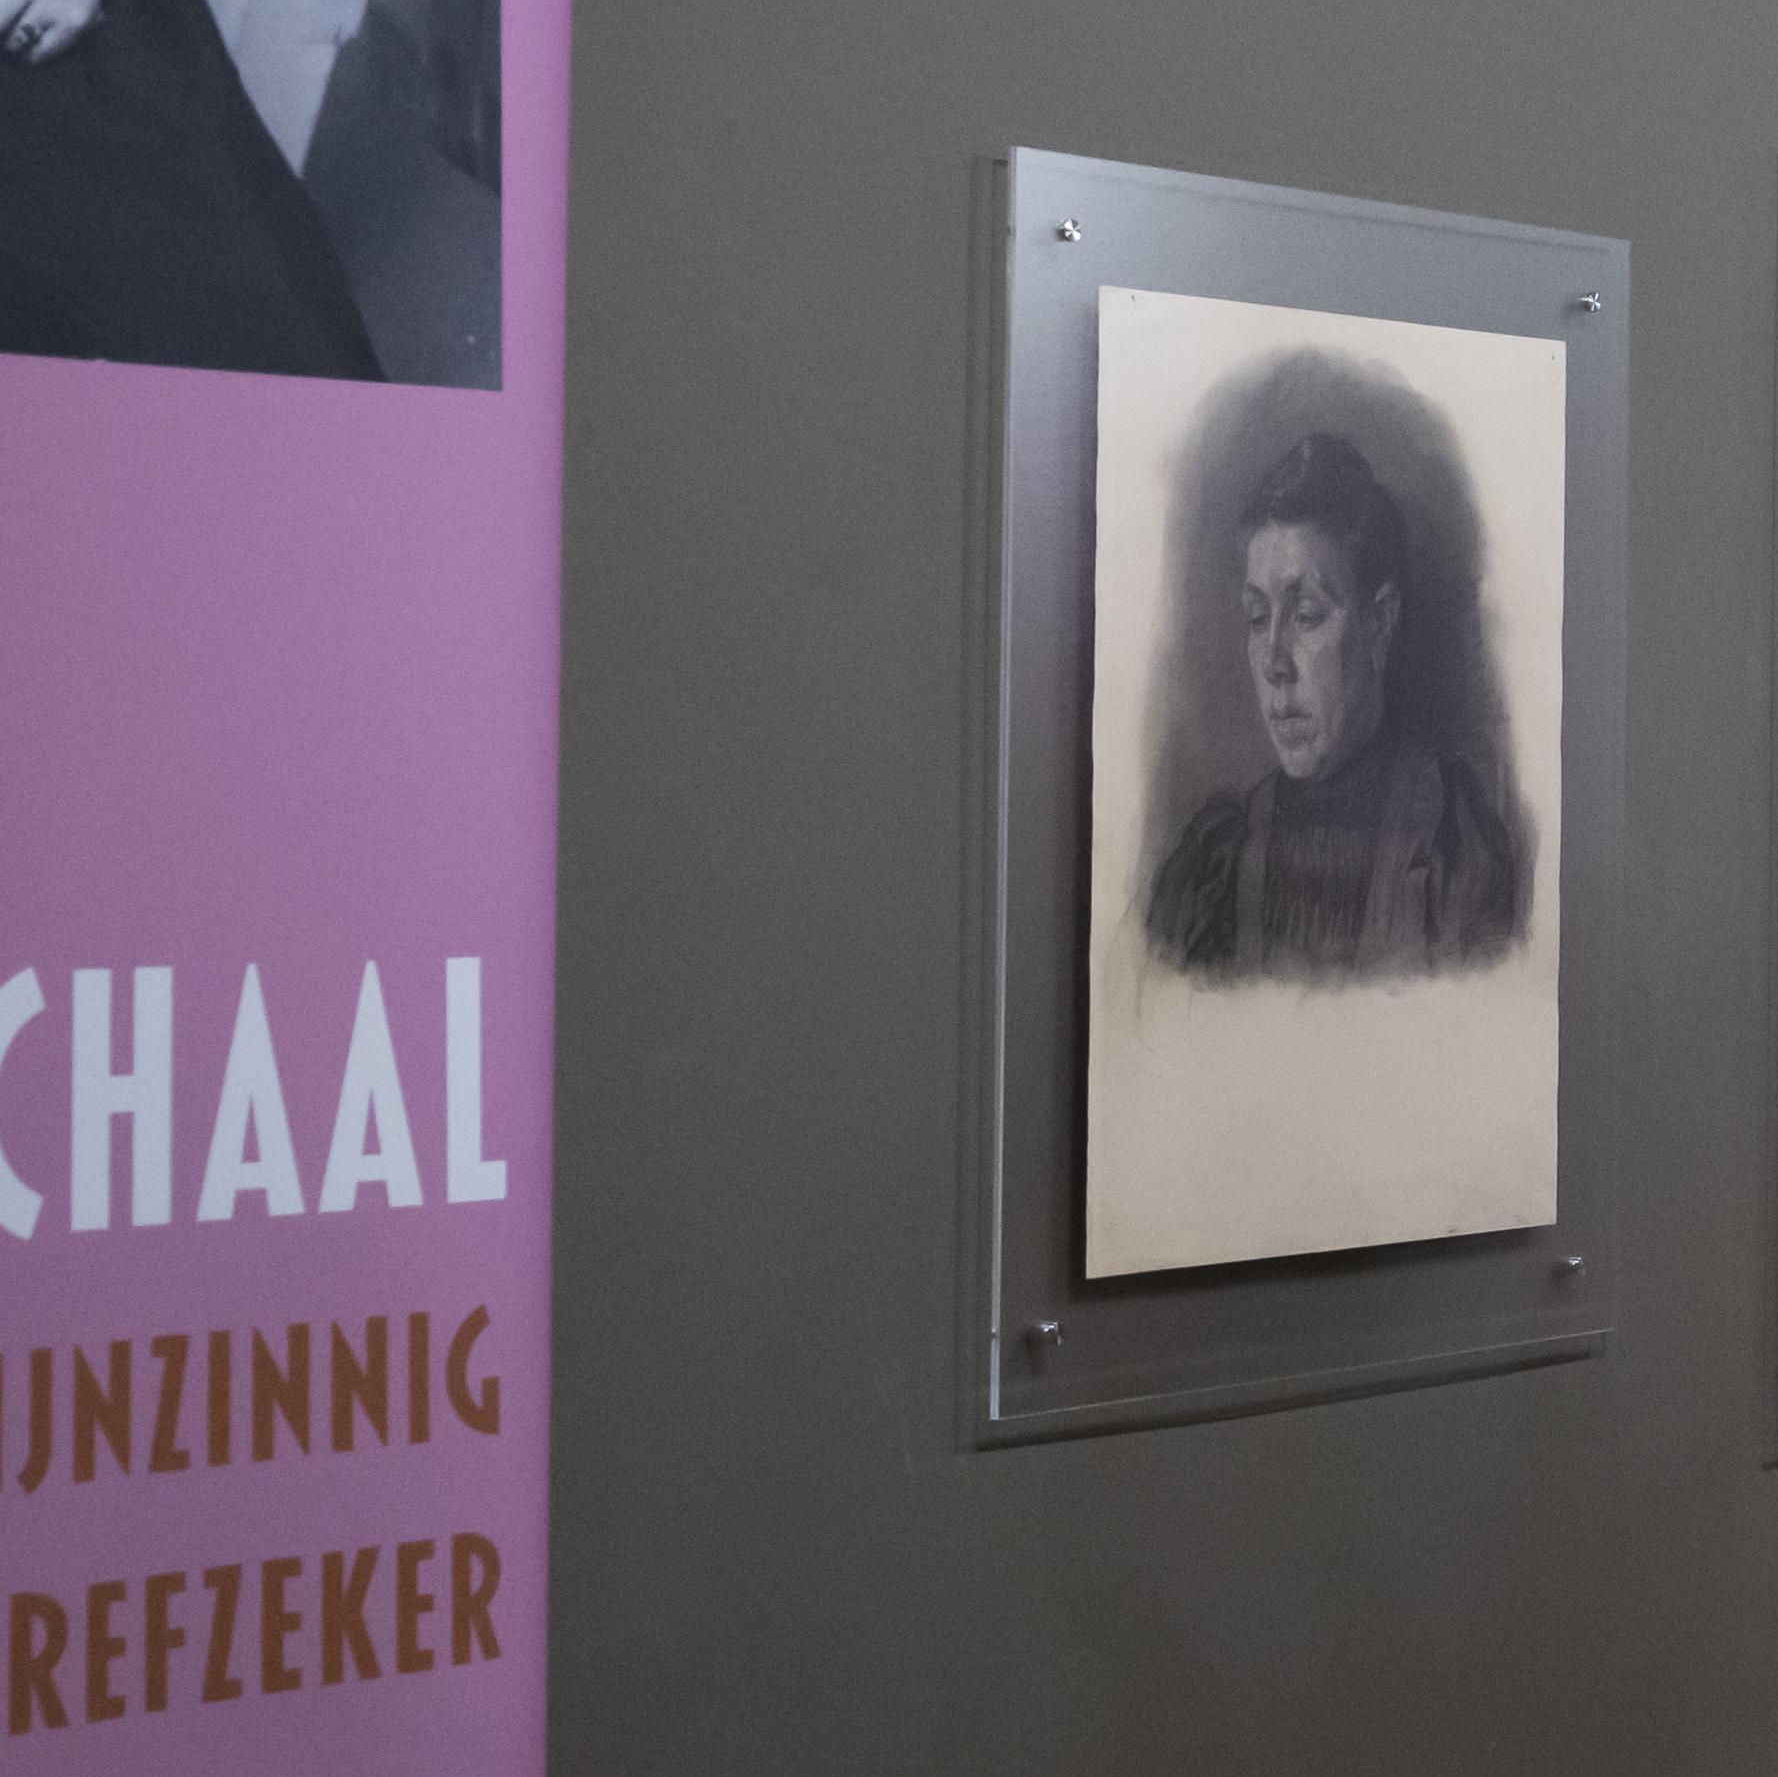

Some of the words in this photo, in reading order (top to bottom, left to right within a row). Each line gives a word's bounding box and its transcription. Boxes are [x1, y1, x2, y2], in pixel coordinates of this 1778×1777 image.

[0, 955, 508, 1241] CHAAL
[0, 1303, 502, 1496] JNZINNIG
[8, 1530, 503, 1737] REFZEKER
